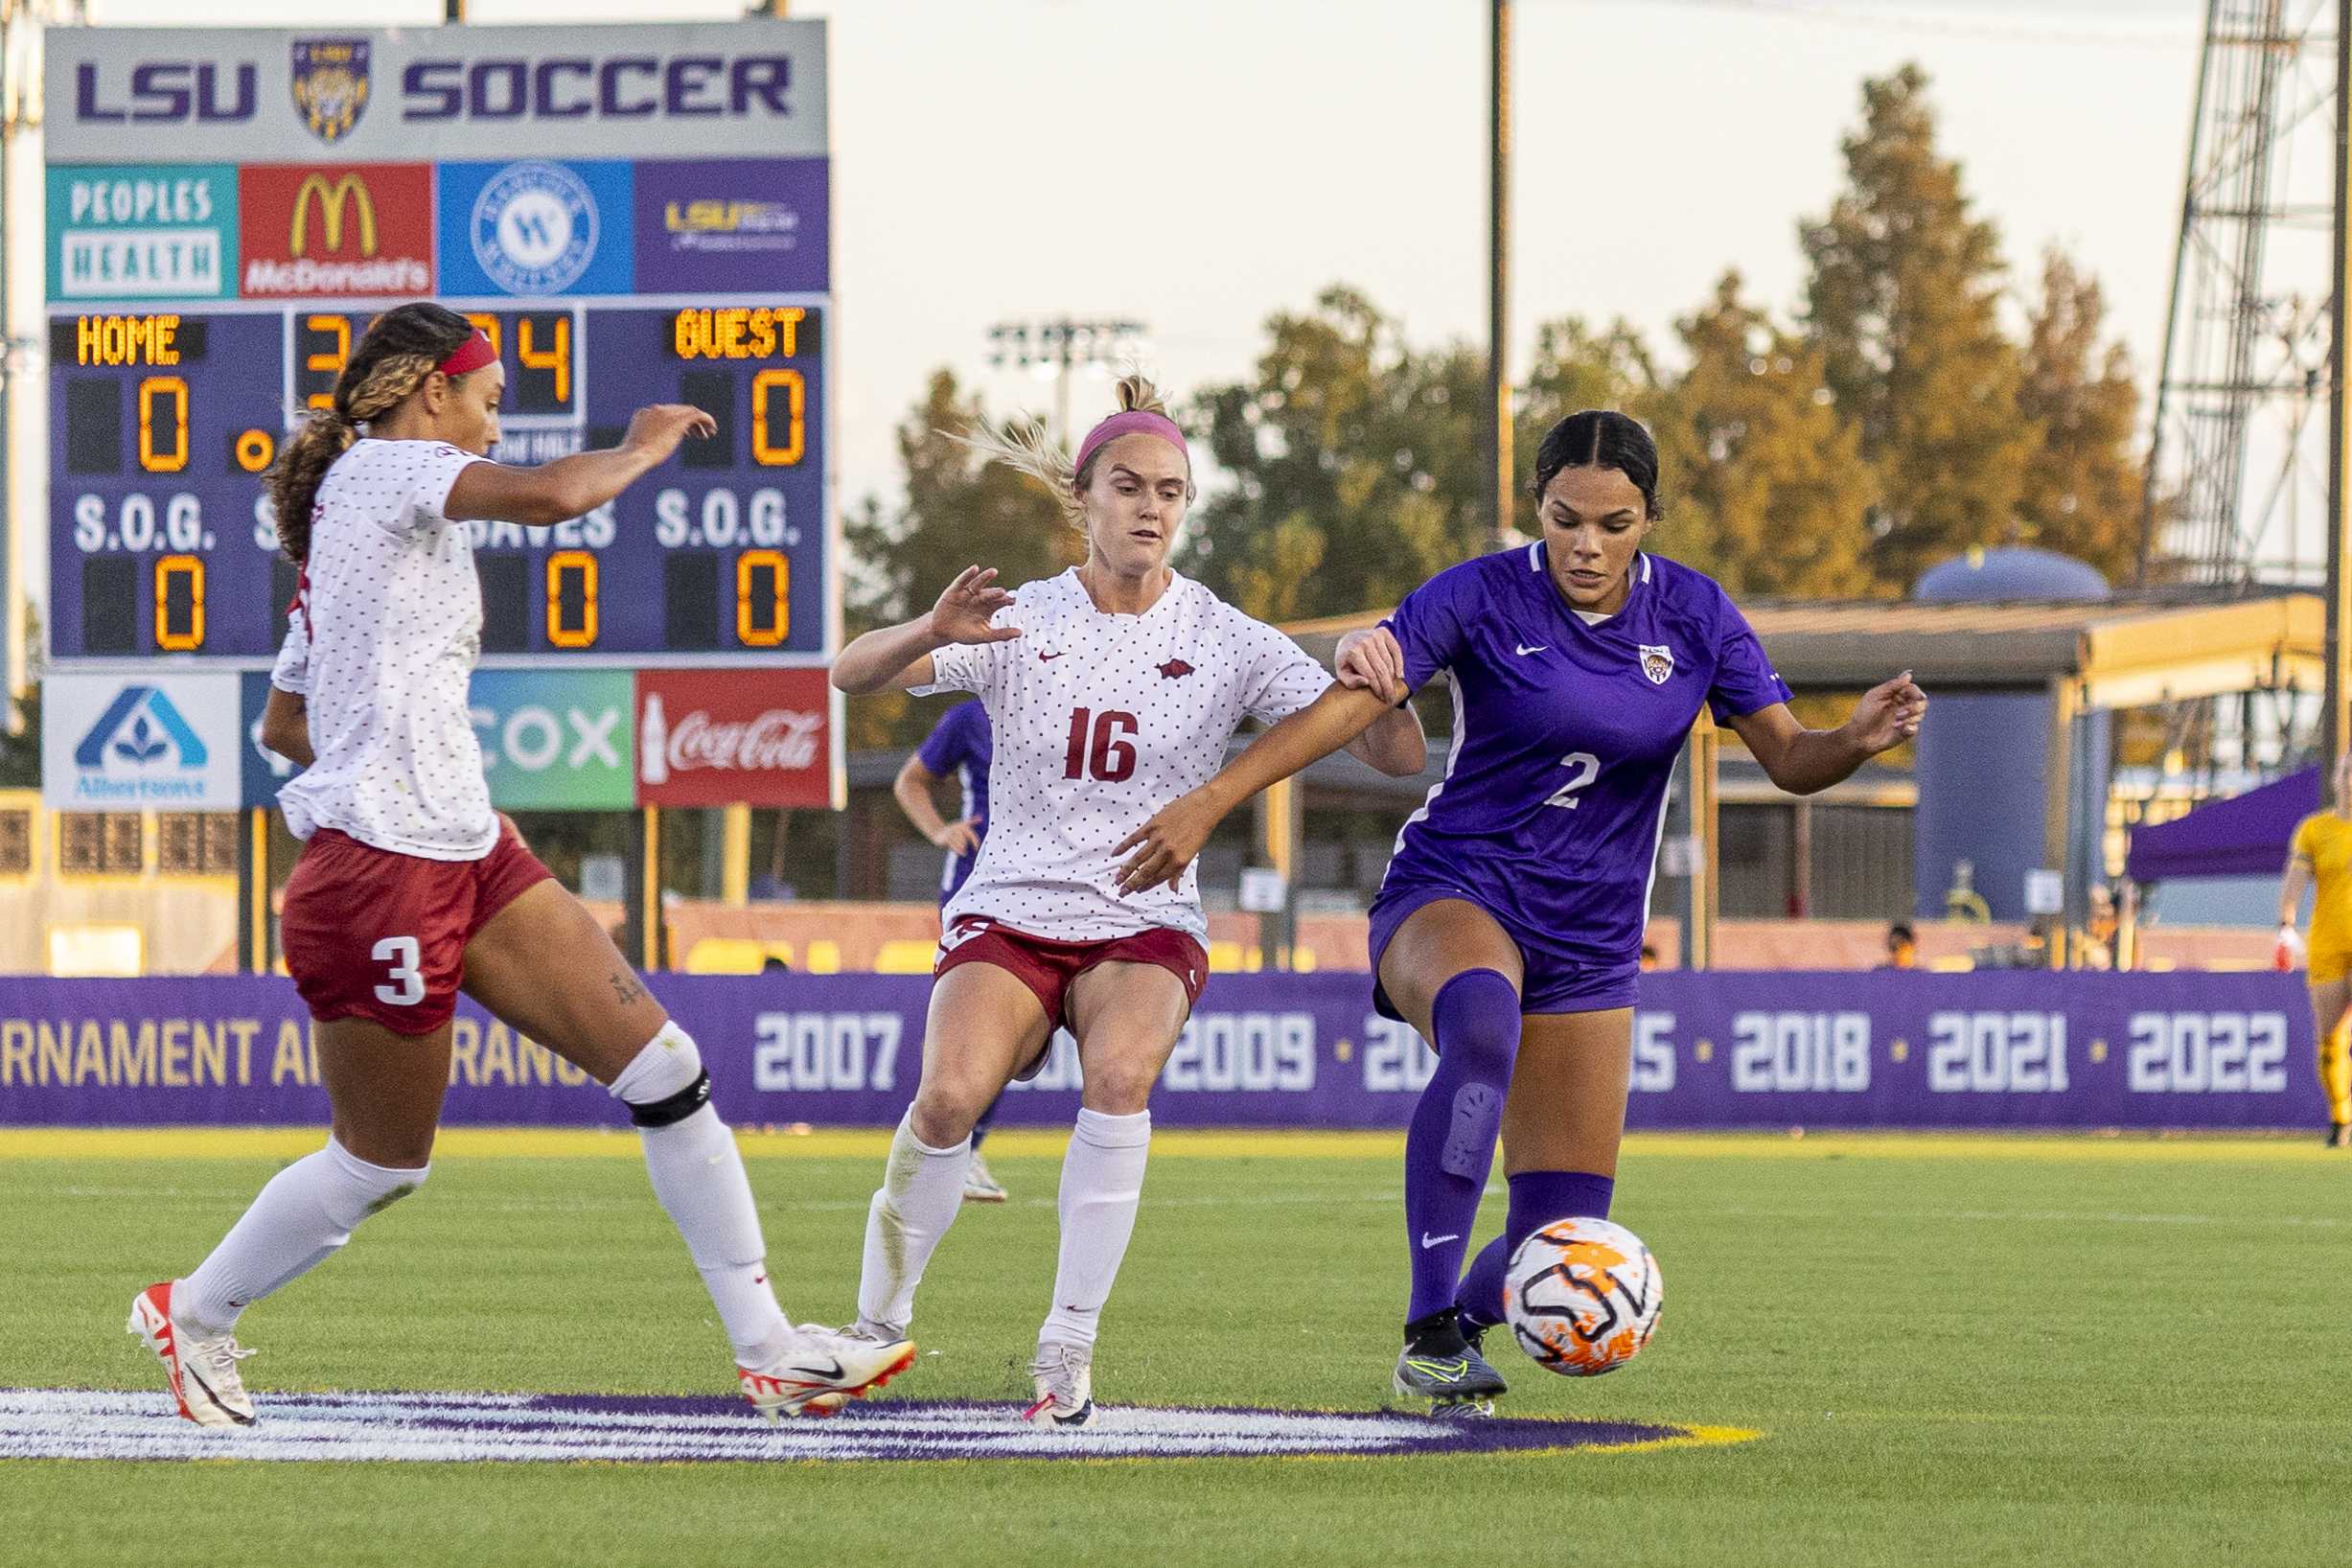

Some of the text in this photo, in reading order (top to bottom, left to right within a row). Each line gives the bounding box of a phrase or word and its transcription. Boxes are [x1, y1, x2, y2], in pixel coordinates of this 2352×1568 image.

[76, 55, 792, 122] LSU SOCCER
[71, 179, 213, 222] PEOPLES
[664, 199, 738, 231] LSU
[73, 242, 211, 283] HEALTH
[246, 259, 430, 291] McDonald's
[78, 314, 180, 366] HOME
[675, 307, 806, 359] GUEST
[138, 376, 189, 472] 0
[751, 368, 805, 466] 0
[74, 492, 217, 553] S.O.G.
[656, 487, 801, 548] S.O.G.
[155, 554, 205, 651] 0
[546, 550, 598, 648] 0
[736, 549, 790, 647] 0
[1063, 706, 1140, 782] 16
[1543, 751, 1601, 810] 2
[371, 935, 427, 1006] 3
[753, 1011, 903, 1092] 2007
[1164, 1011, 1317, 1092] 2009
[1363, 1011, 1441, 1092] 20
[1732, 1011, 1871, 1093] 2018
[1927, 1011, 2069, 1093] 2021
[2128, 1011, 2288, 1093] 2022
